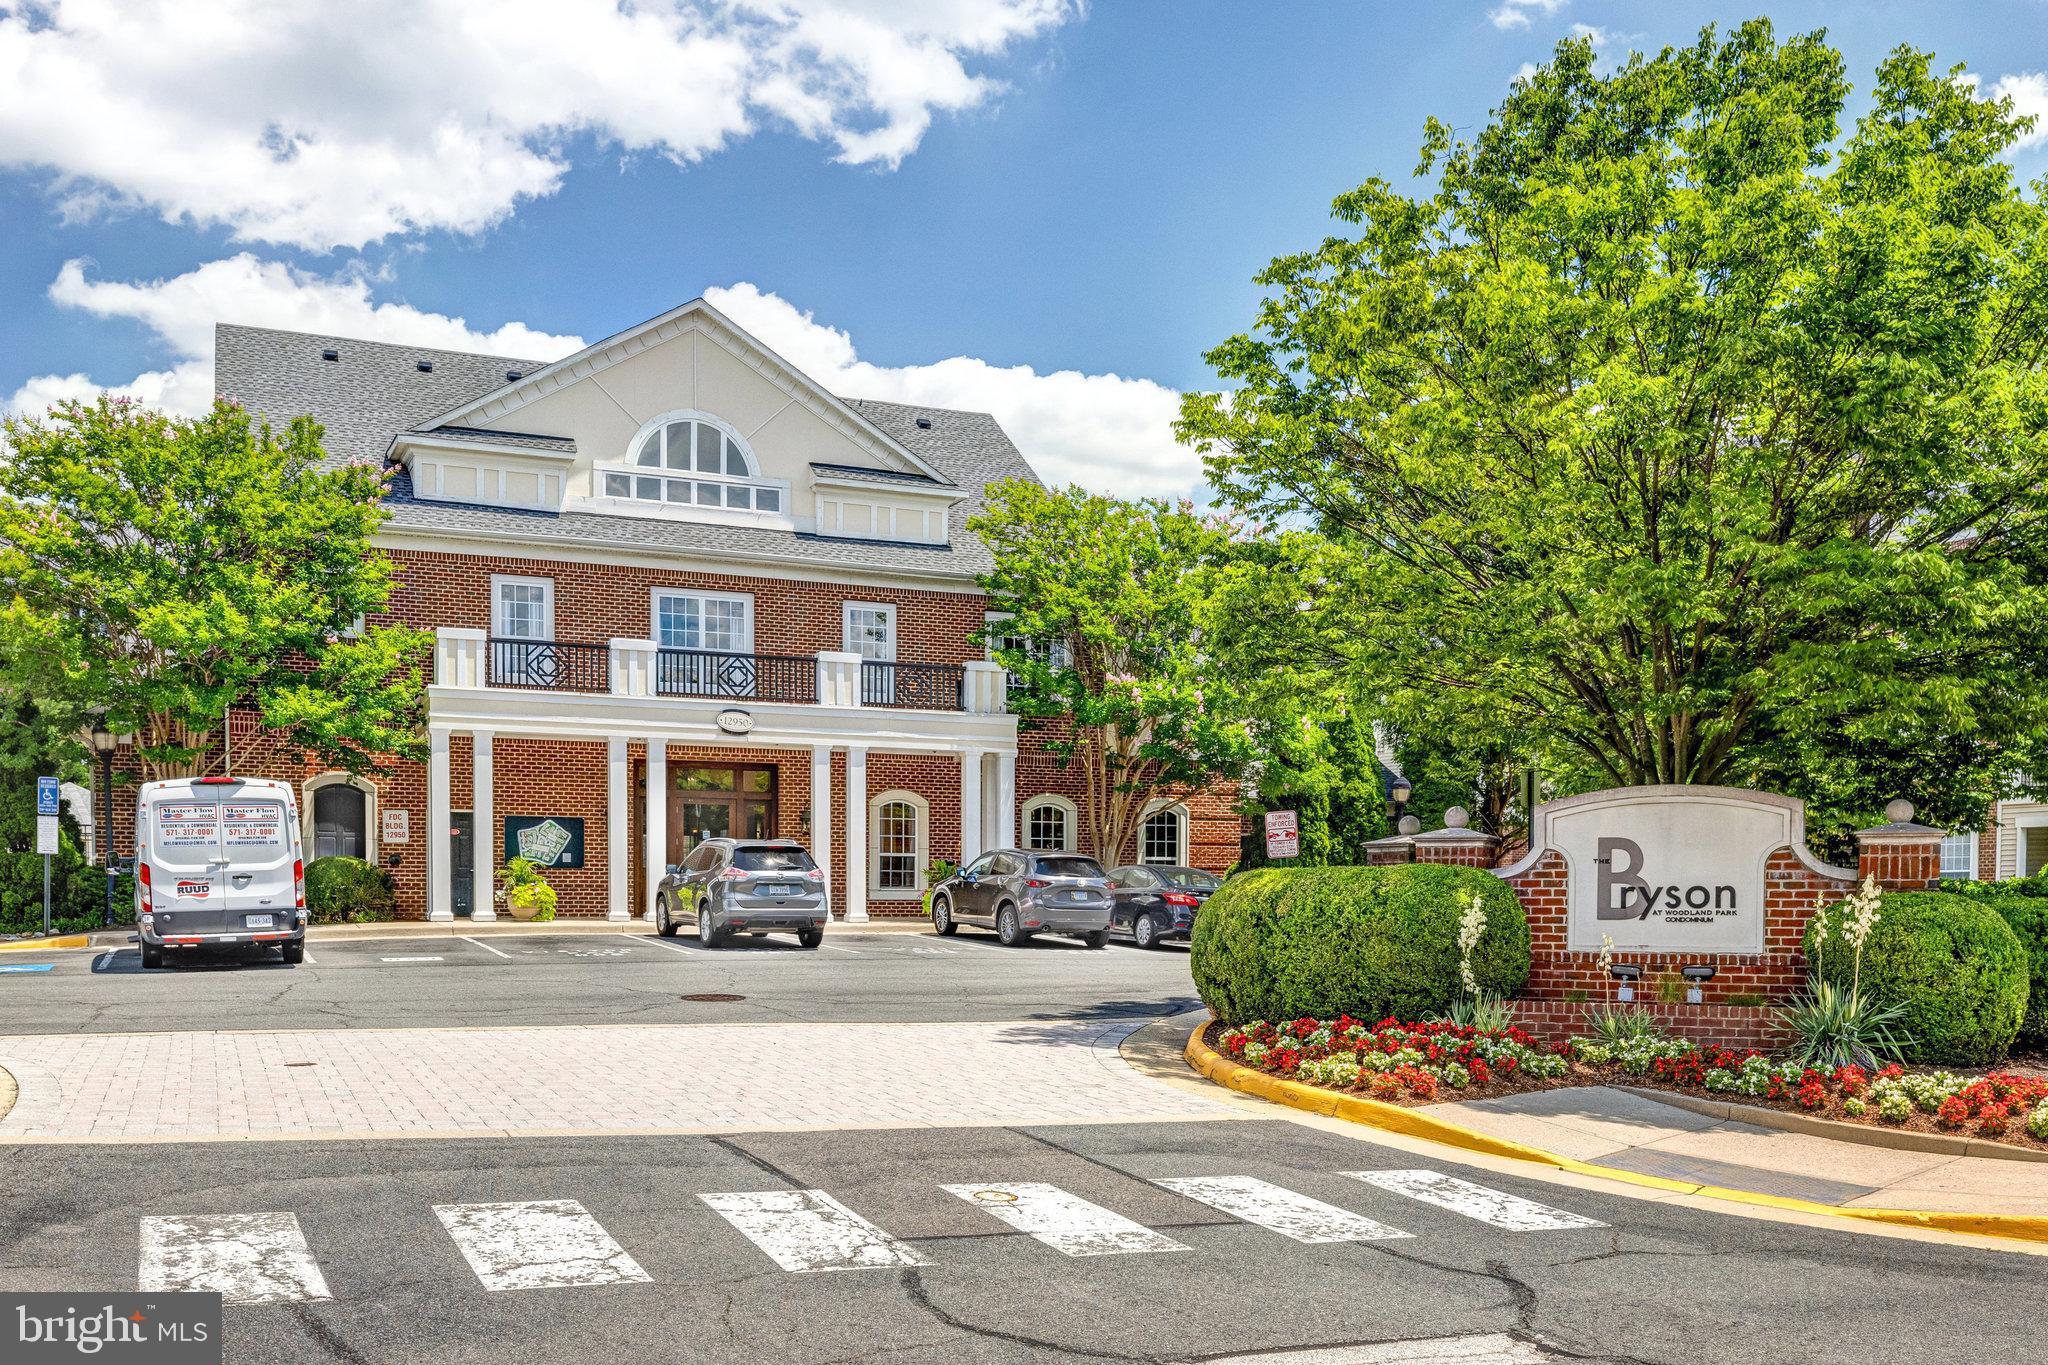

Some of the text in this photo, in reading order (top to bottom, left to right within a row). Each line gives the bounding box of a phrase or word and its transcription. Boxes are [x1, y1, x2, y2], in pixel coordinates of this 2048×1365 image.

[724, 717, 749, 727] 12950
[385, 822, 406, 830] BLDG.
[1597, 837, 1736, 921] Bryson
[177, 885, 210, 894] RUUD
